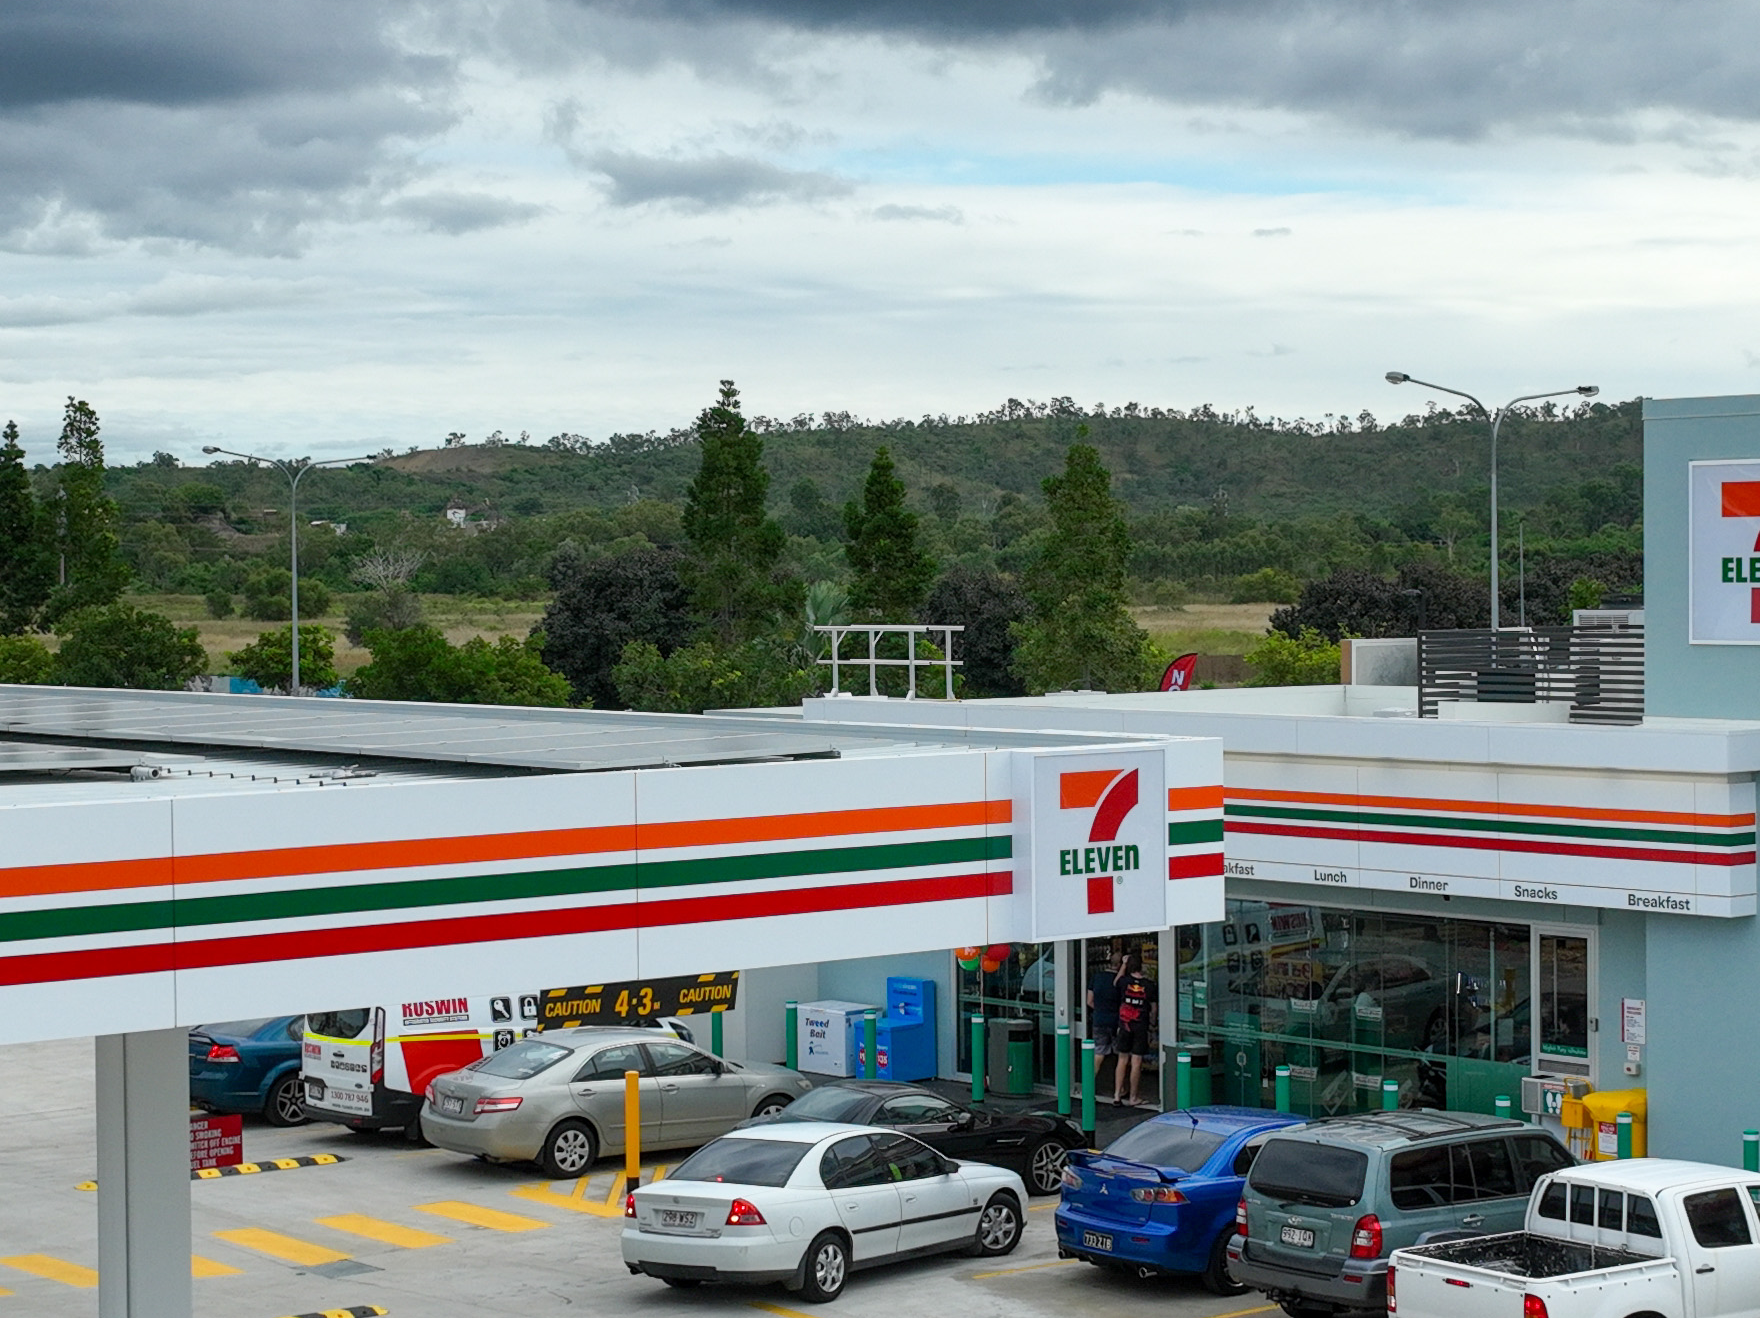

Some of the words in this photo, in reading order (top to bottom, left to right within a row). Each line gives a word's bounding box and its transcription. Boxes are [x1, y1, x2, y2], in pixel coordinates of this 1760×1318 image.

[1223, 863, 1255, 876] akfast
[1314, 869, 1347, 883] Lunch
[1409, 877, 1449, 891] Dinner
[1514, 885, 1558, 900] Snacks
[1628, 894, 1691, 910] Breakfast
[401, 997, 469, 1018] RUSWIN
[545, 998, 601, 1018] CAUTION
[679, 984, 732, 1004] CAUTION
[805, 1017, 829, 1028] Tweed
[810, 1028, 826, 1039] Bait
